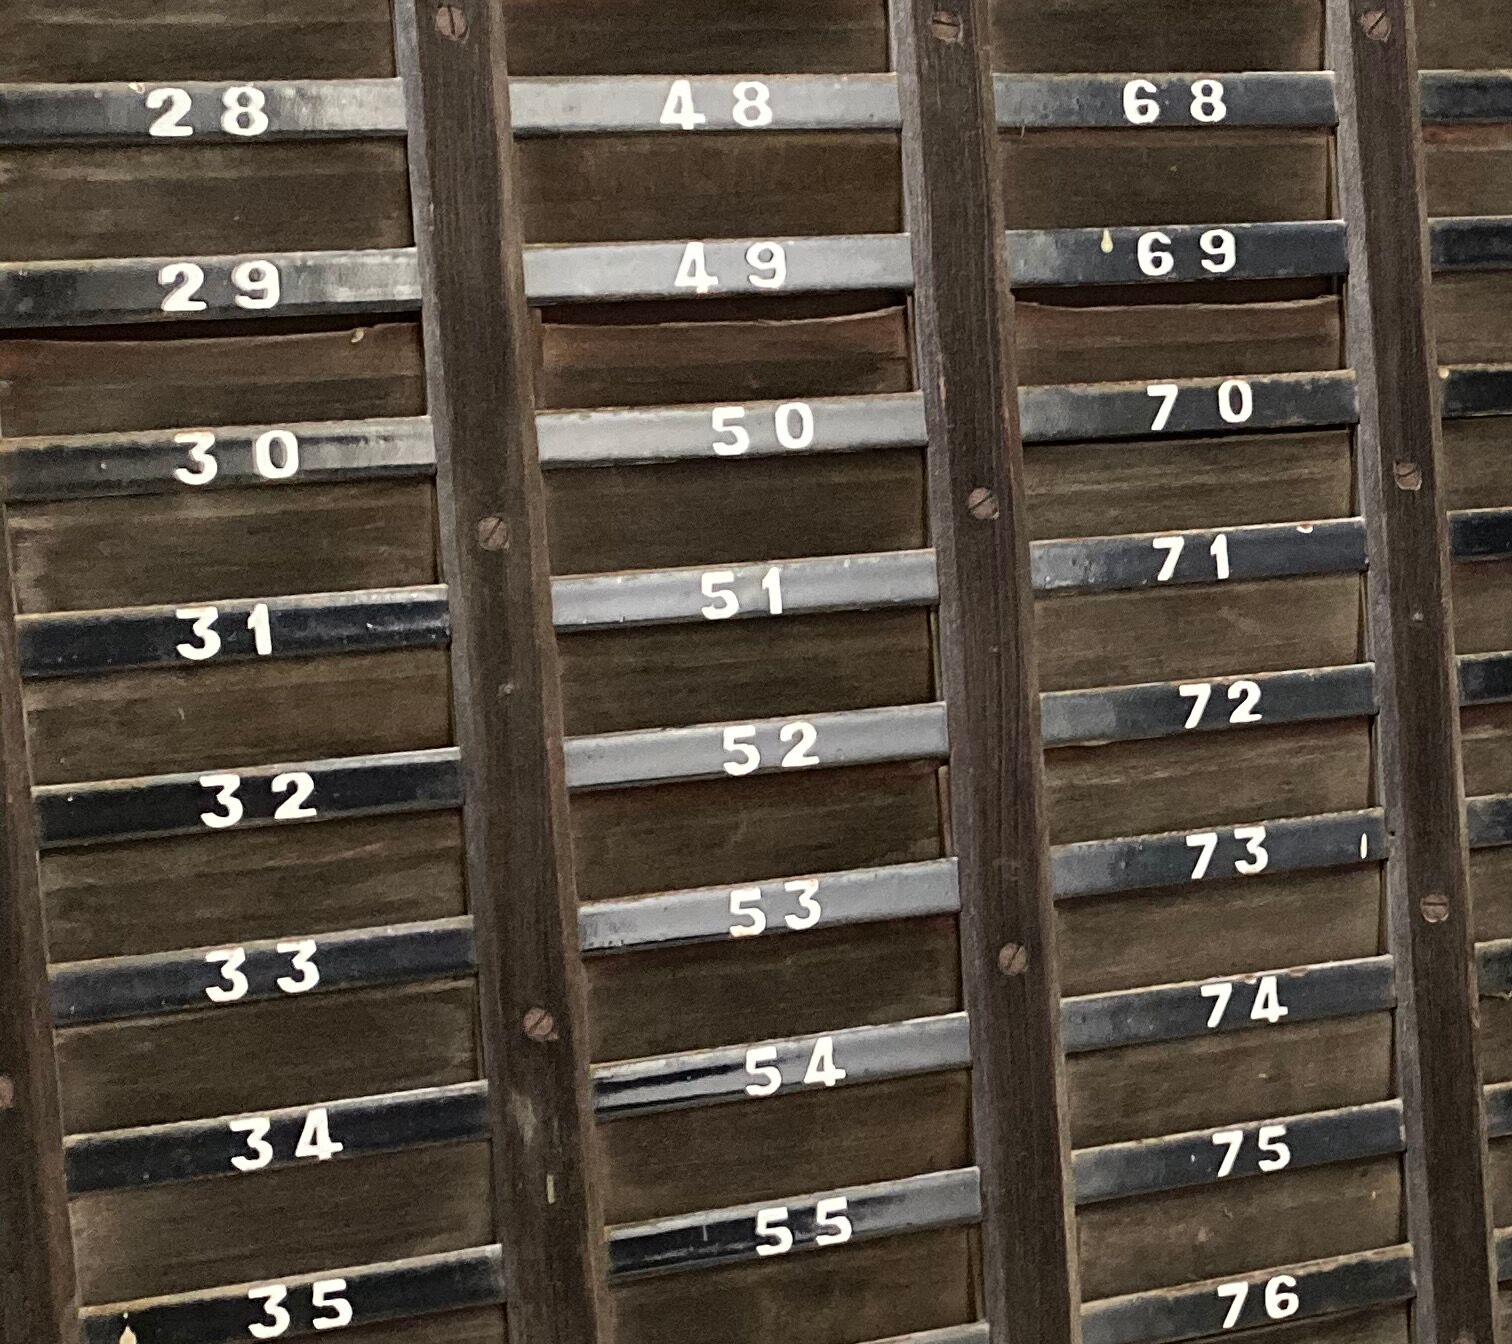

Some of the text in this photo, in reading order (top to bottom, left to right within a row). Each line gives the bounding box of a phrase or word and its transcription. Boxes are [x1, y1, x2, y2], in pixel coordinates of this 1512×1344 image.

[146, 81, 268, 136] 28
[660, 79, 773, 129] 48
[1124, 79, 1226, 124] 68
[159, 260, 280, 311] 29
[674, 241, 786, 293] 49
[1147, 376, 1252, 430] 70
[174, 430, 299, 485] 30
[1153, 534, 1229, 581] 71
[701, 565, 782, 619] 51
[1179, 680, 1262, 729] 72
[721, 721, 819, 775] 52
[199, 772, 317, 828] 32
[730, 879, 821, 936] 53
[205, 936, 319, 1001] 33
[1201, 976, 1288, 1027] 74
[229, 1108, 343, 1171] 34
[1212, 1124, 1290, 1177] 75
[756, 1196, 851, 1255] 55
[1217, 1275, 1299, 1328] 76
